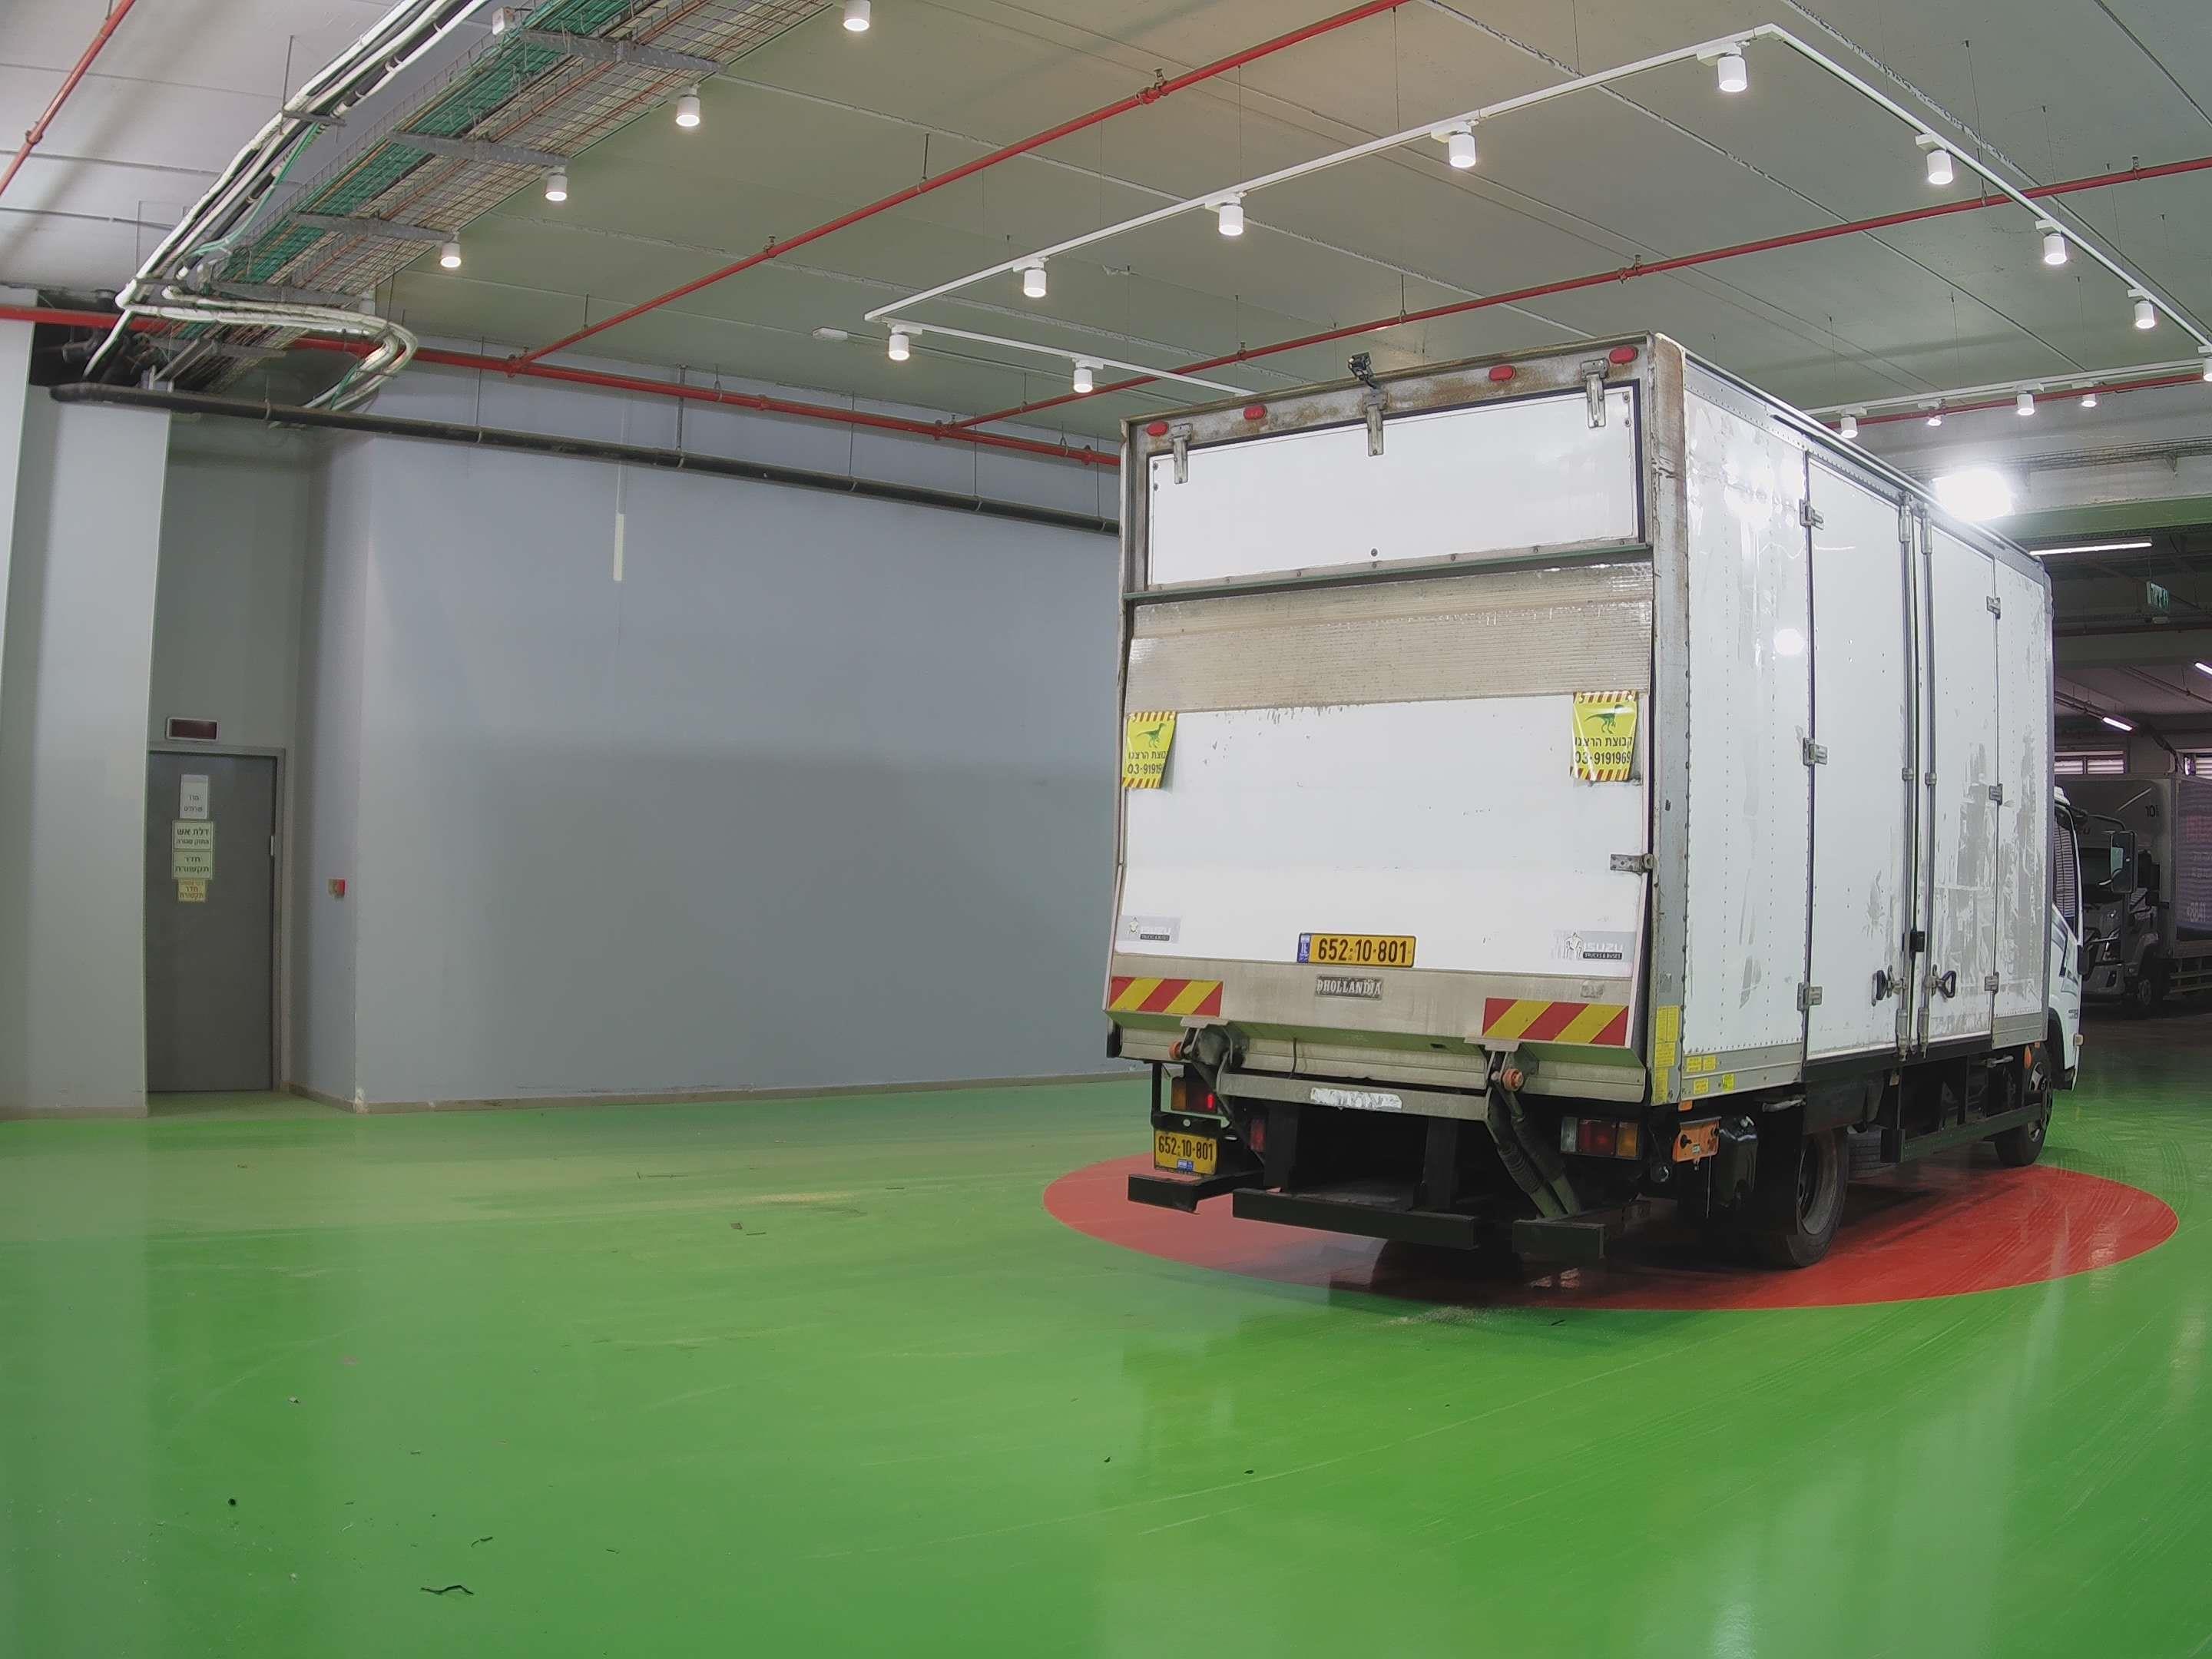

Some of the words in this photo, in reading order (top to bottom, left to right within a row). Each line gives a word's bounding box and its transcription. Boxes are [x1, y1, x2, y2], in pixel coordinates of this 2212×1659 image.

[1604, 737, 1633, 748] קבוצת
[1575, 750, 1631, 765] 03-9191969
[193, 827, 209, 836] דלת
[175, 866, 210, 874] תקשורת
[1584, 942, 1623, 952] ISUZU
[1316, 979, 1382, 997] DHOLLANDIA
